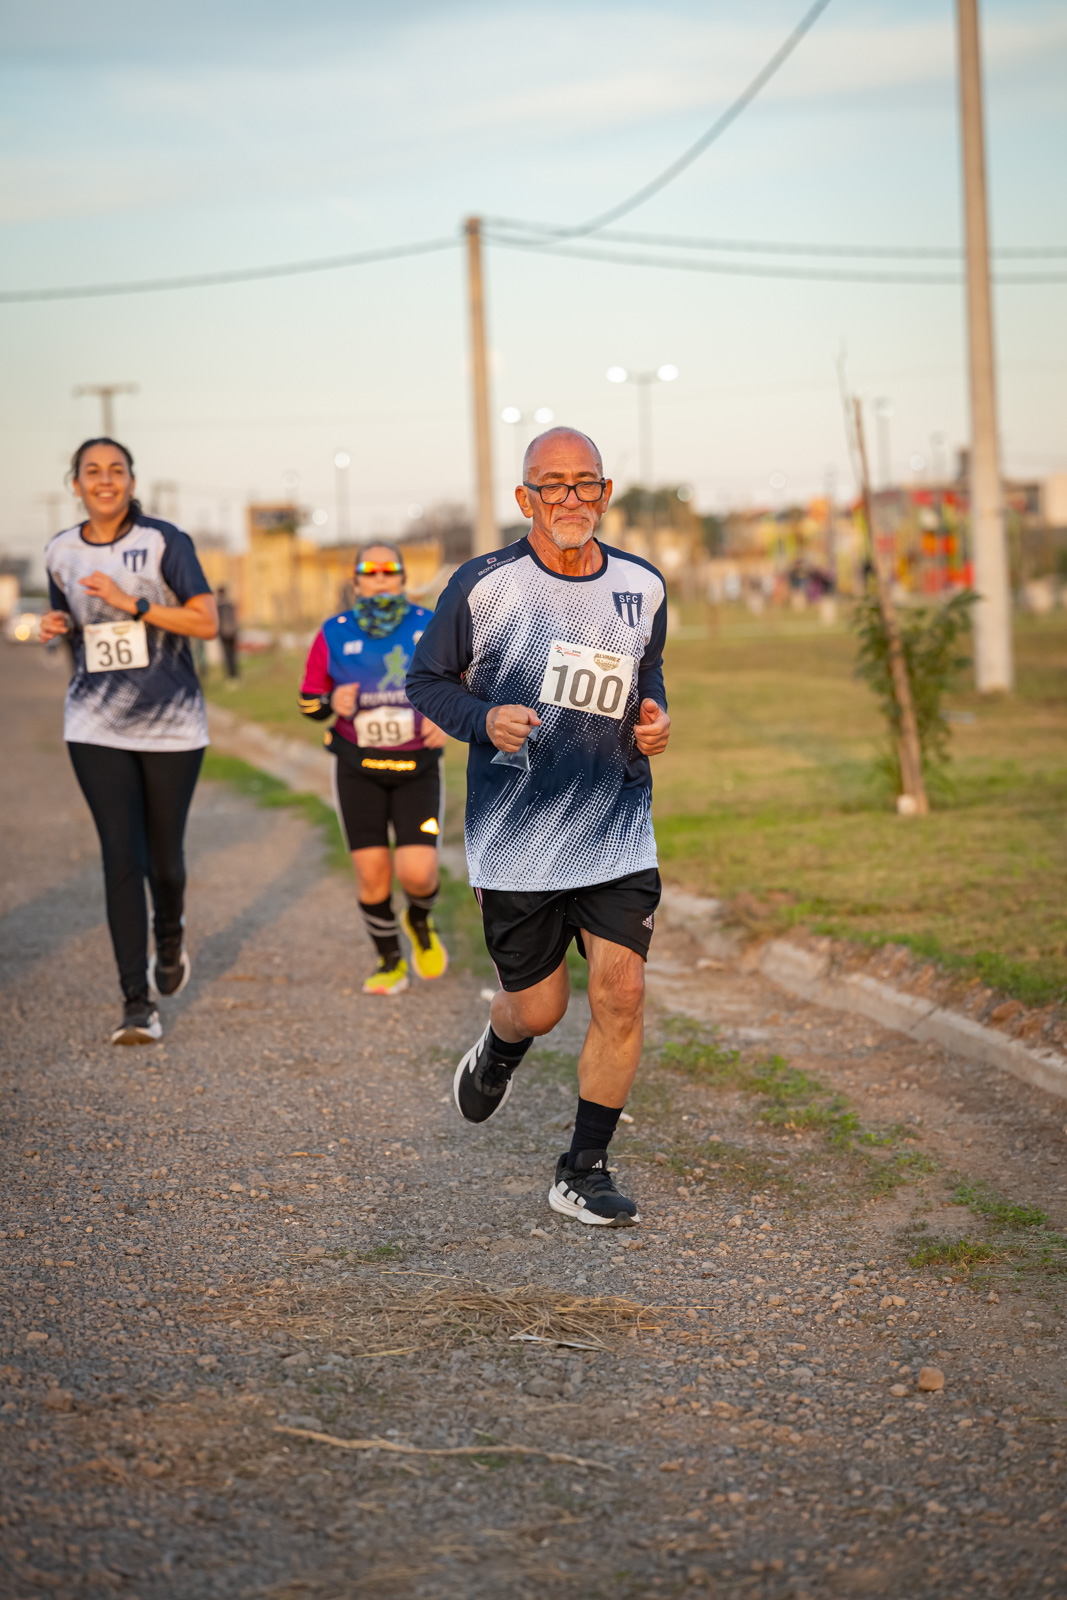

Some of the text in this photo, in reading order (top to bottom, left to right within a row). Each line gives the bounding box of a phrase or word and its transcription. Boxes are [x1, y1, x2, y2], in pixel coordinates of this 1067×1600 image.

[619, 594, 639, 604] SFC
[96, 639, 133, 667] 36
[552, 664, 624, 714] 100
[367, 721, 401, 743] 99
